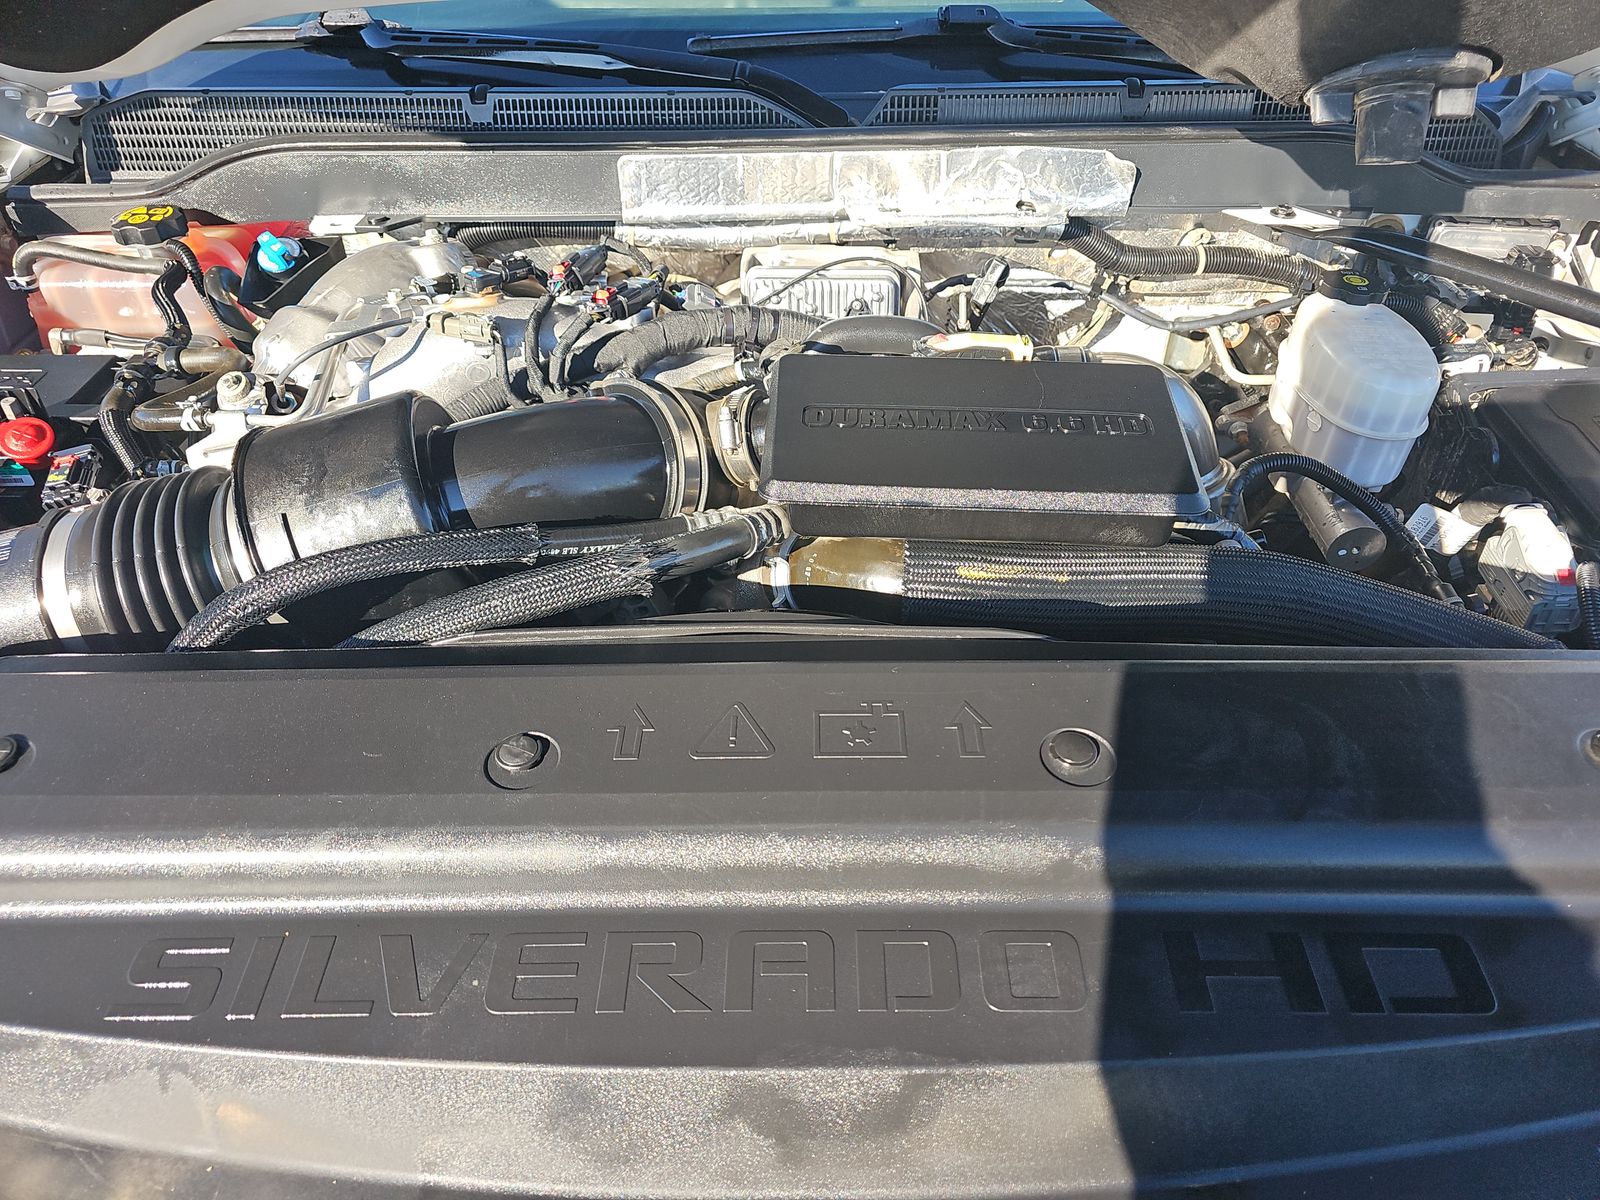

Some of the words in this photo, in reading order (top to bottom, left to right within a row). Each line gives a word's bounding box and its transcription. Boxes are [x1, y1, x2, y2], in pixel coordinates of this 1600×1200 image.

[802, 407, 1008, 432] DURAMAX
[1020, 414, 1086, 434] 6.6
[1091, 414, 1150, 437] HD
[103, 929, 1088, 1020] SILVERADO
[1160, 929, 1499, 1017] HD
